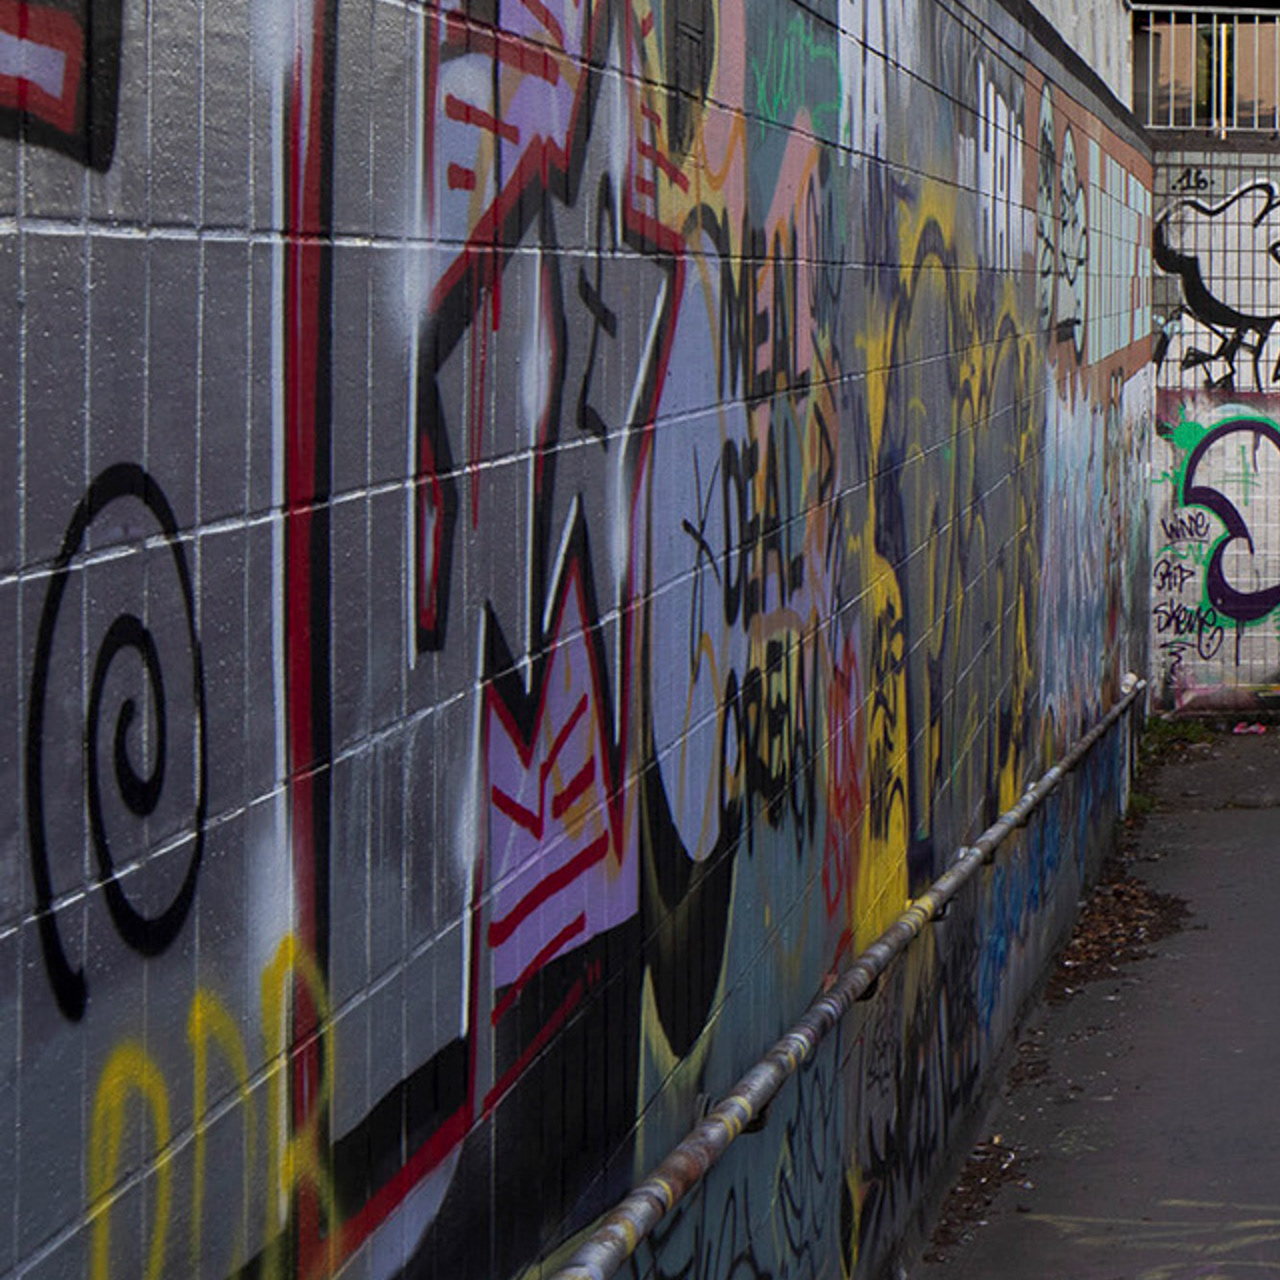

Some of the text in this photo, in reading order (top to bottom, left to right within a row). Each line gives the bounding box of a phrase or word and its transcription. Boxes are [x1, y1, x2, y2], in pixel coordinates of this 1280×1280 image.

[718, 206, 811, 411] MEAL
[722, 418, 804, 633] DEAL
[718, 617, 821, 862] CREW
